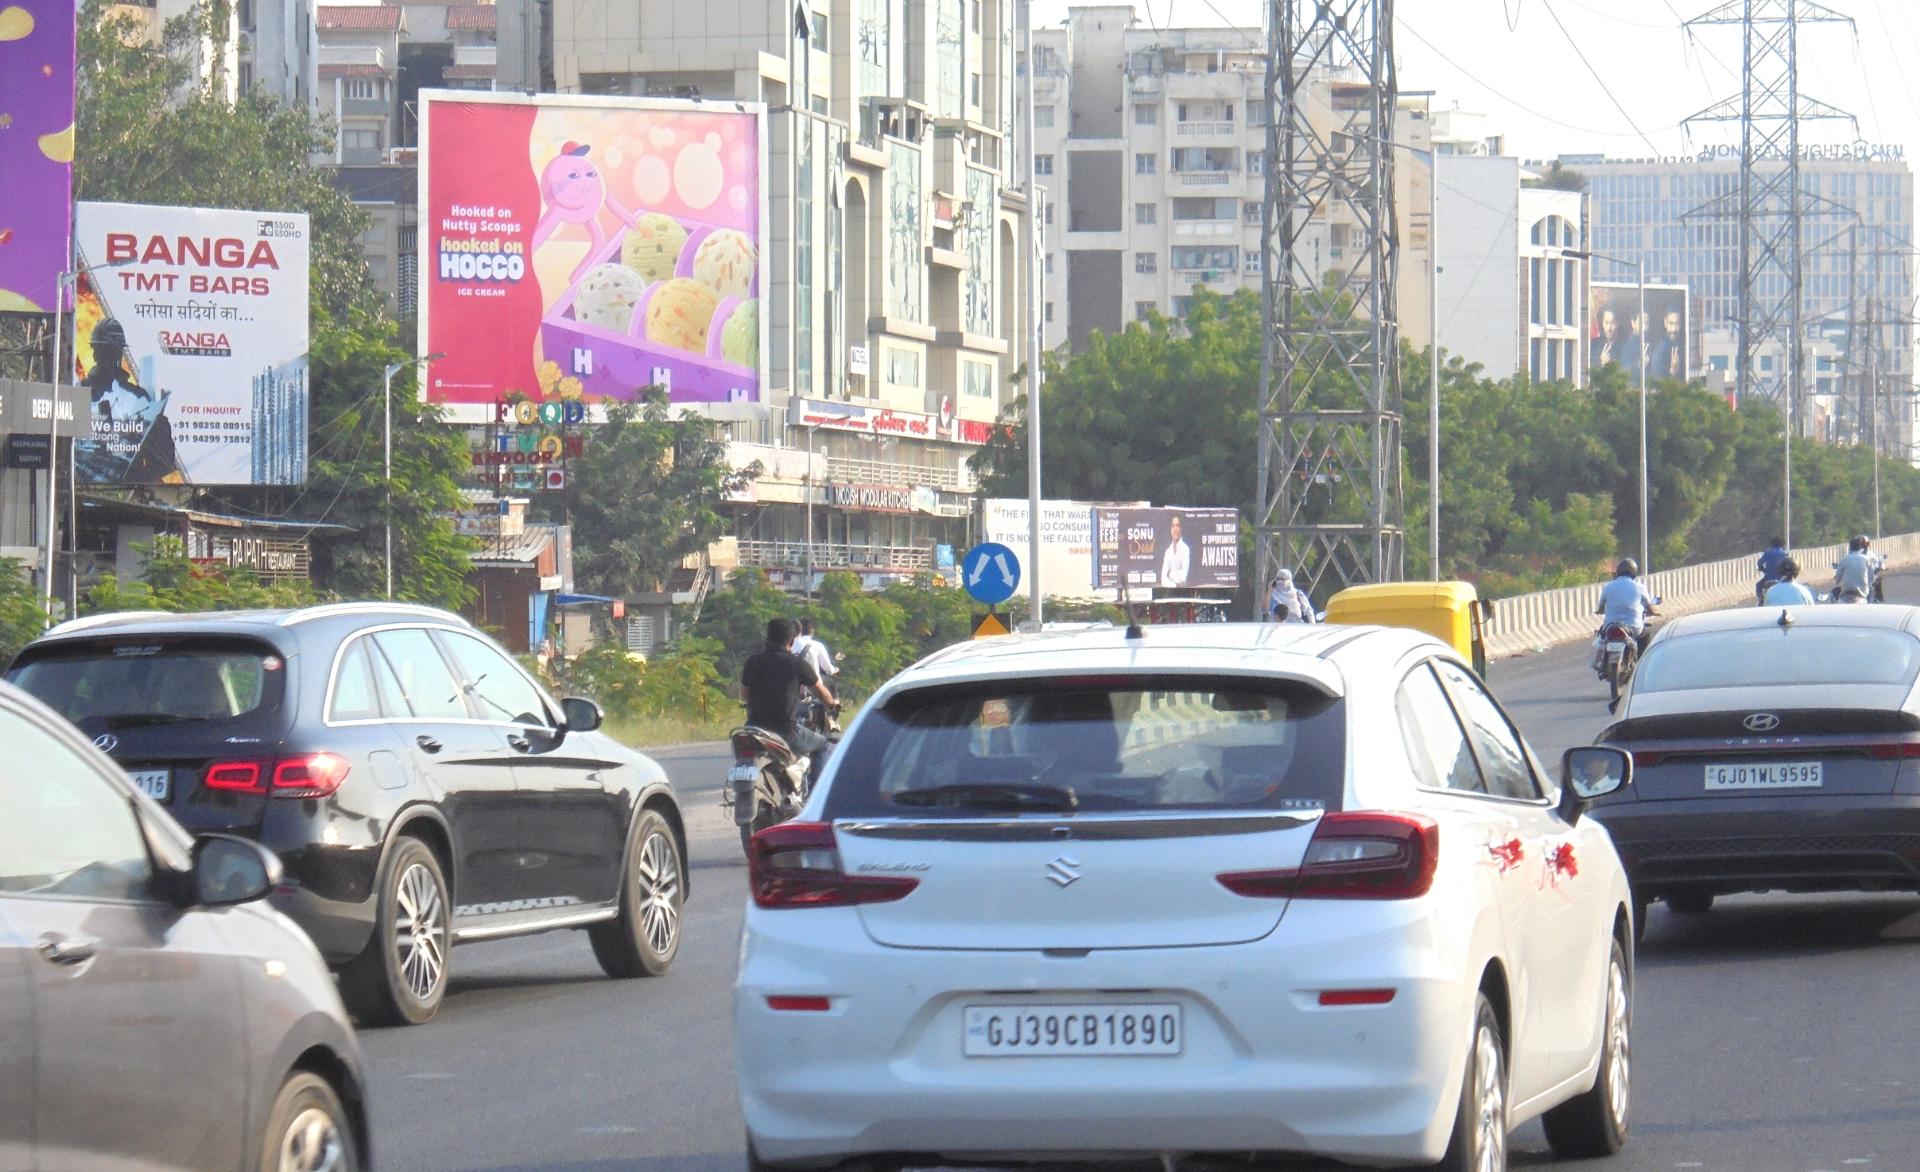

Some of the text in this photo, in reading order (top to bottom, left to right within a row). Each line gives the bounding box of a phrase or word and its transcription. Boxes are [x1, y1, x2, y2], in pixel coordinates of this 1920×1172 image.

[1703, 144, 1784, 159] MONEAL
[452, 205, 511, 218] Hooked on
[443, 219, 521, 235] Nutty Scoops
[106, 233, 280, 270] BANGA
[440, 236, 524, 254] hooked on
[440, 253, 524, 280] HOCCO
[118, 272, 270, 296] TMT BARS
[475, 289, 505, 297] CREAM
[134, 299, 173, 319] भरोसा
[177, 299, 217, 321] सदियों
[32, 398, 74, 420] DEEPAMAL
[181, 405, 241, 415] FOR INQUIRY
[495, 400, 584, 426] FOOD
[91, 420, 144, 433] We Build
[106, 442, 141, 452] Nation!
[1043, 510, 1066, 520] THAT
[1052, 522, 1091, 532] CONSUM
[1127, 528, 1154, 540] SONU
[996, 533, 1004, 542] IT
[1006, 533, 1015, 543] IS
[1017, 534, 1031, 543] NO
[1057, 534, 1083, 545] FAULT
[1717, 765, 1819, 785] GJ01WL9595
[987, 1013, 1175, 1047] GJ39CB1890
